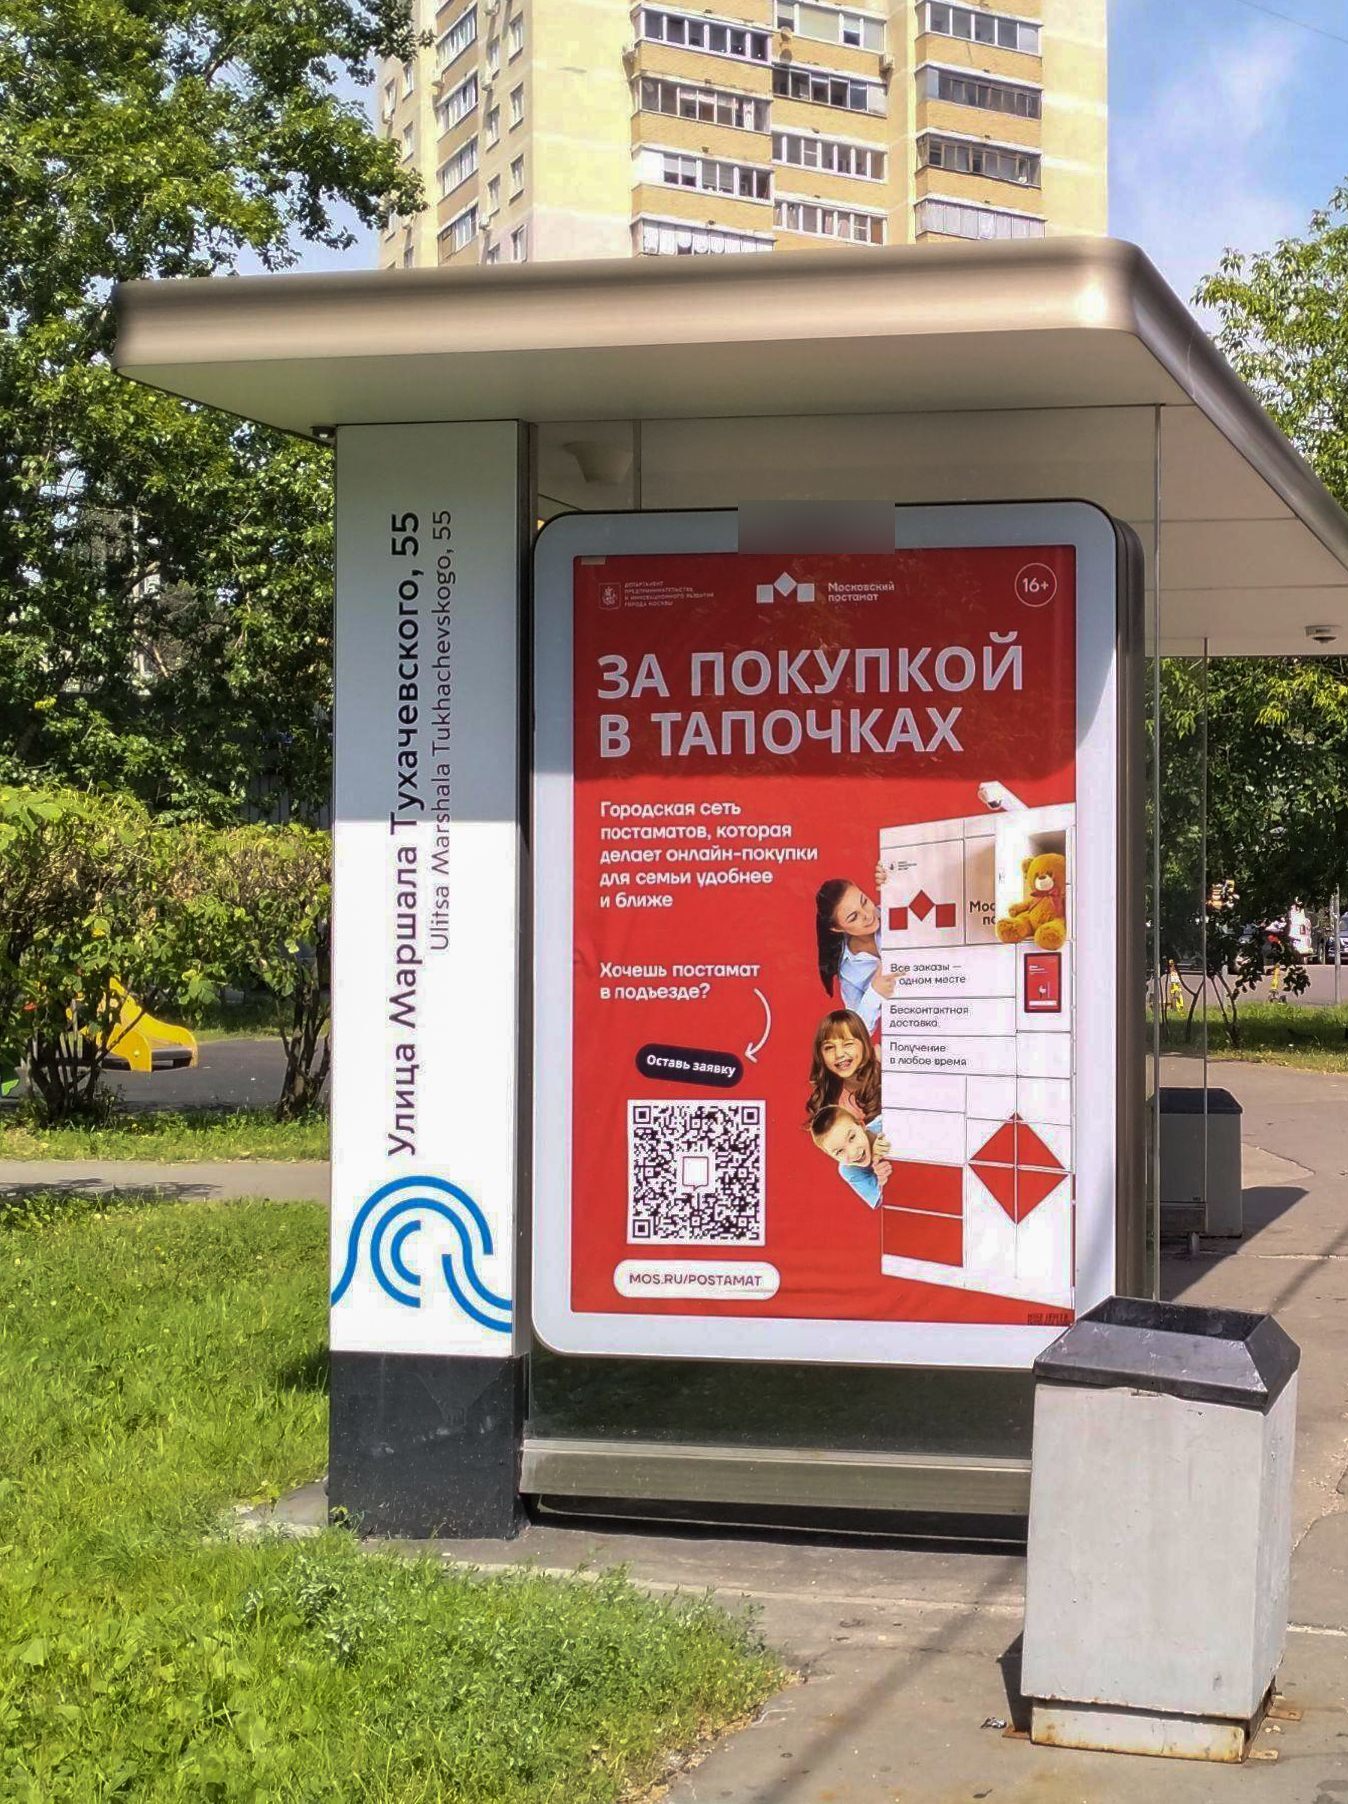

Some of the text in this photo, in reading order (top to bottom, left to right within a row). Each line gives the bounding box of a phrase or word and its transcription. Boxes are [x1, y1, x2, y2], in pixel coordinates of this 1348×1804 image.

[828, 581, 895, 592] Московский
[1022, 577, 1048, 593] 16+
[597, 630, 1023, 700] ЗА ПОКУПКОЙ
[430, 510, 455, 950] Ulitsa Marshala Tukhachevskogo, 55
[600, 707, 964, 758] В ТАПОЧКАХ
[601, 801, 741, 820] Городская сеть
[388, 512, 424, 1156] Улица Маршала Тухачевского, 55
[601, 824, 792, 841] постаматов, которая
[600, 845, 817, 864] делает онлайн-покупки
[600, 868, 773, 888] для семьи удобнее
[601, 892, 673, 908] и ближе
[600, 963, 759, 978] Хочешь постамат
[891, 963, 910, 972] Все
[913, 964, 949, 972] заказы
[899, 976, 965, 985] одном месте
[601, 984, 710, 1001] в подъезде?
[890, 1005, 968, 1014] Бесконтактная
[890, 1042, 946, 1054] Получение
[646, 1054, 736, 1078] Оставь заявку
[898, 1056, 931, 1064] любое
[935, 1058, 966, 1066] время
[630, 1272, 762, 1287] MOS.RU/POSTAMAT
